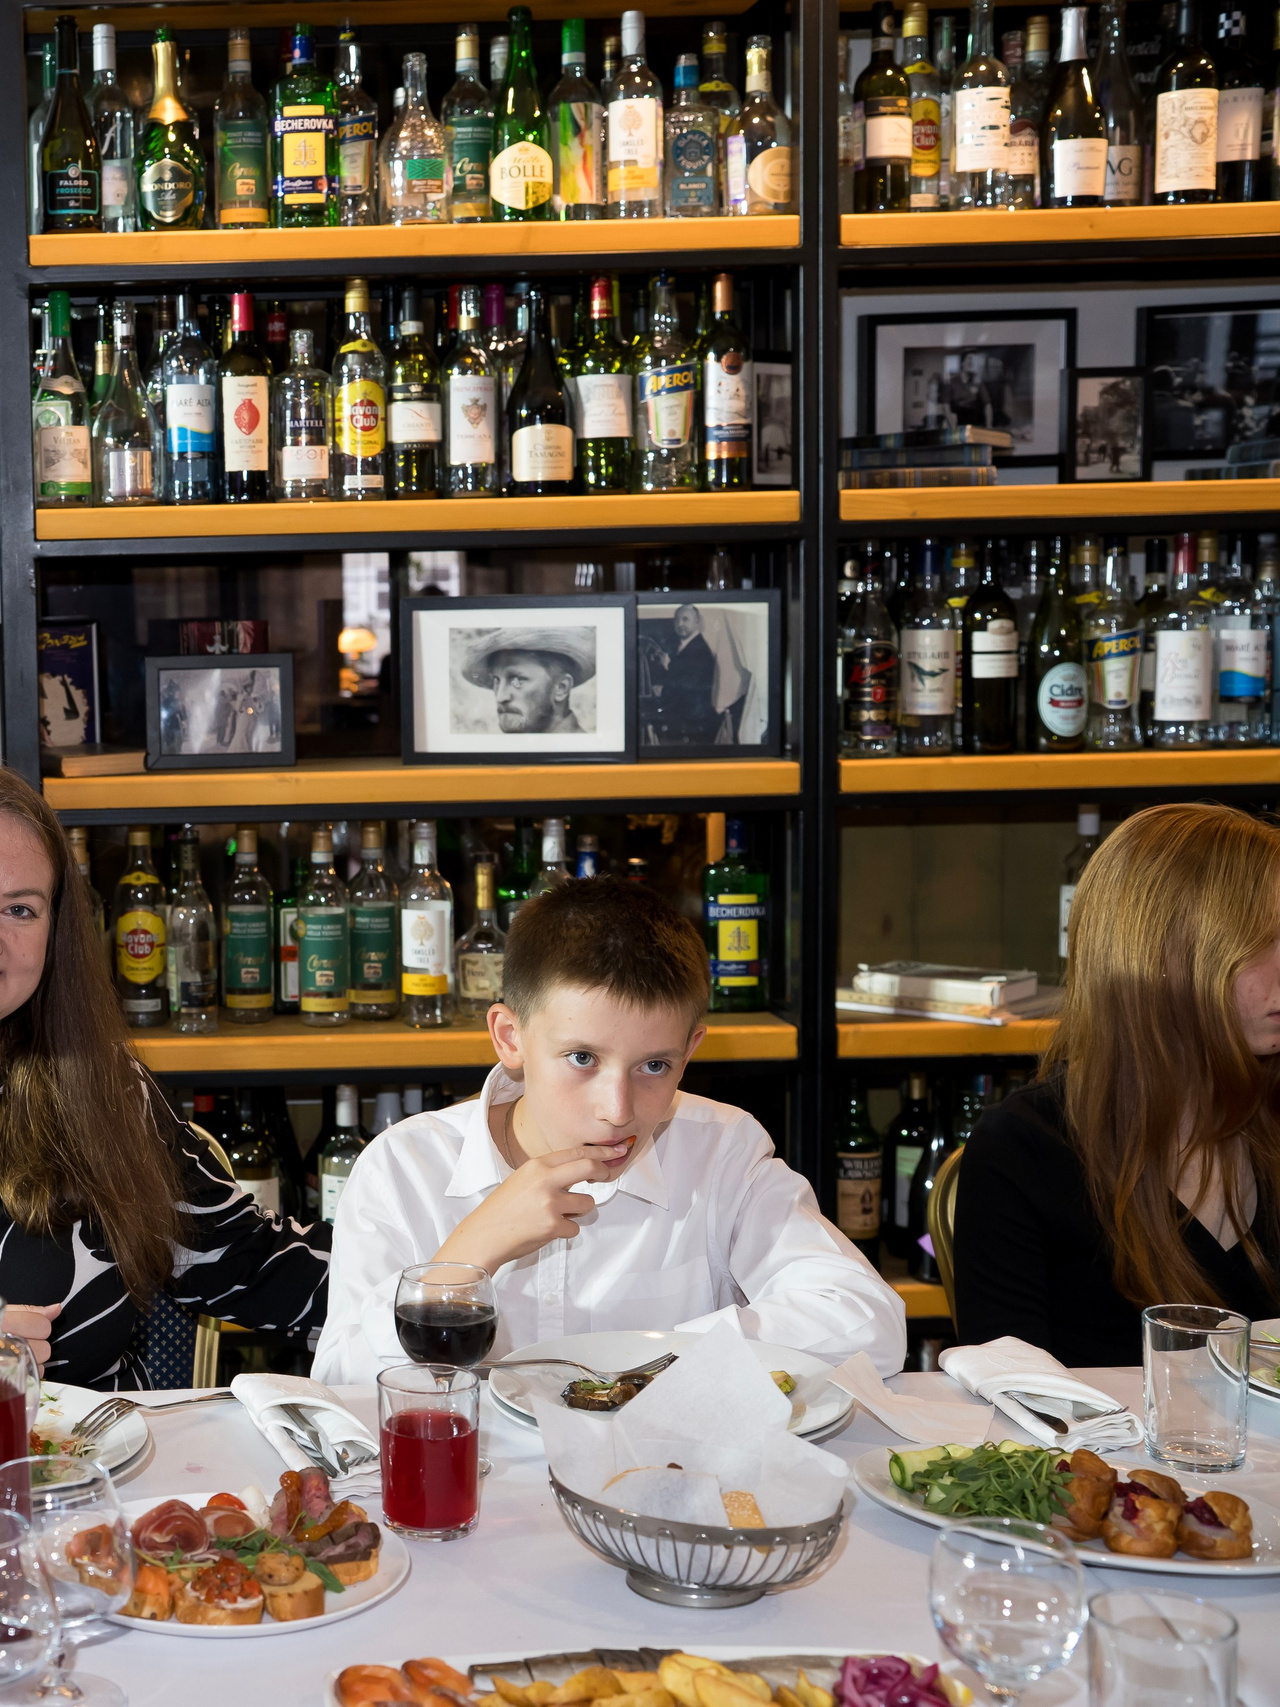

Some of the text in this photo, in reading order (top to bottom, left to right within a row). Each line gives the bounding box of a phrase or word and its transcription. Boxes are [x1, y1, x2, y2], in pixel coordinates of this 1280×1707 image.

[274, 118, 334, 132] BECHEROVKA
[339, 121, 374, 139] PEROL
[912, 124, 939, 135] avan
[913, 135, 937, 147] Club
[501, 165, 545, 180] BOLLE
[59, 179, 89, 187] FALDEO
[56, 187, 92, 195] PROSECCO
[645, 371, 694, 395] APEROL
[350, 405, 382, 415] avana
[352, 416, 377, 427] Club
[1092, 637, 1141, 659] APEROL
[708, 906, 766, 918] BECHEROVKA
[122, 932, 158, 944] Havana
[127, 943, 151, 955] Club
